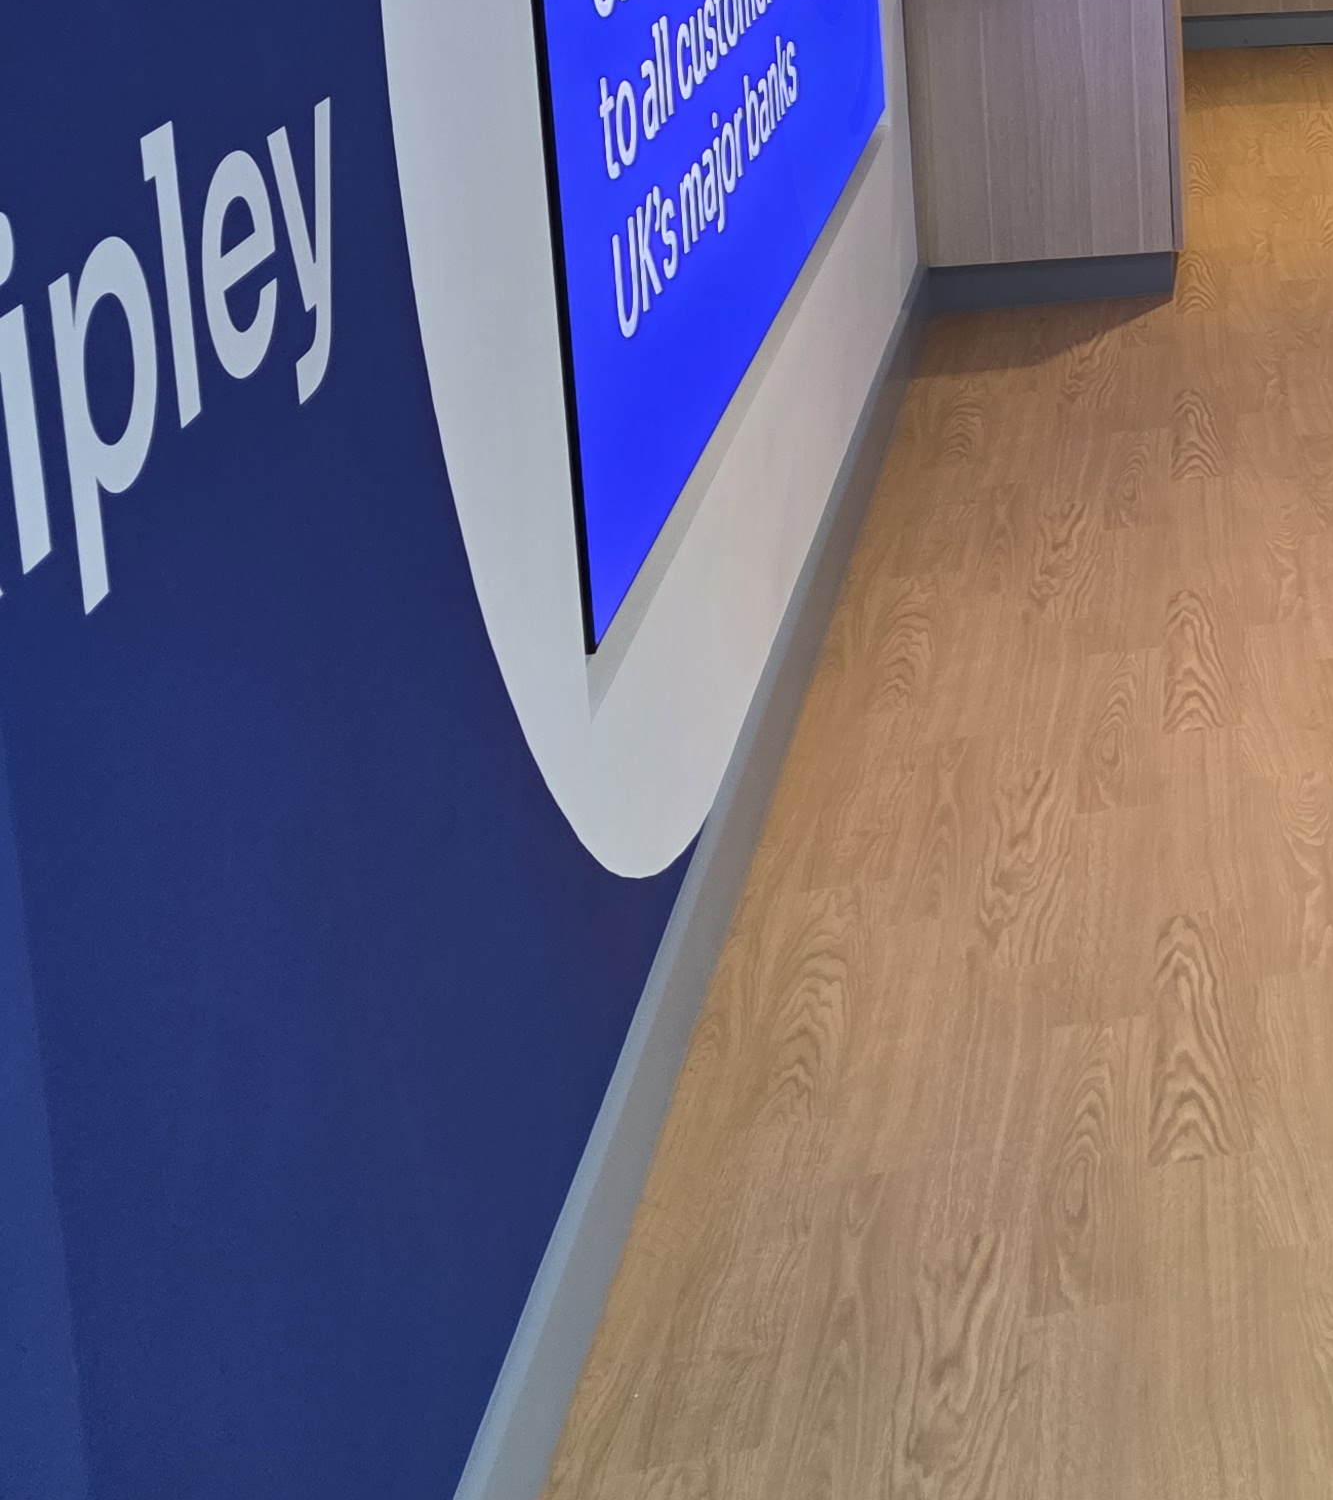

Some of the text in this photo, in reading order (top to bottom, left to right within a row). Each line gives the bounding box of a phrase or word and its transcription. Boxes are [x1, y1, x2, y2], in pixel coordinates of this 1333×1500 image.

[599, 77, 636, 180] to
[642, 15, 675, 139] all
[680, 107, 743, 233] major
[744, 36, 798, 161] banks
[0, 96, 331, 614] ipley
